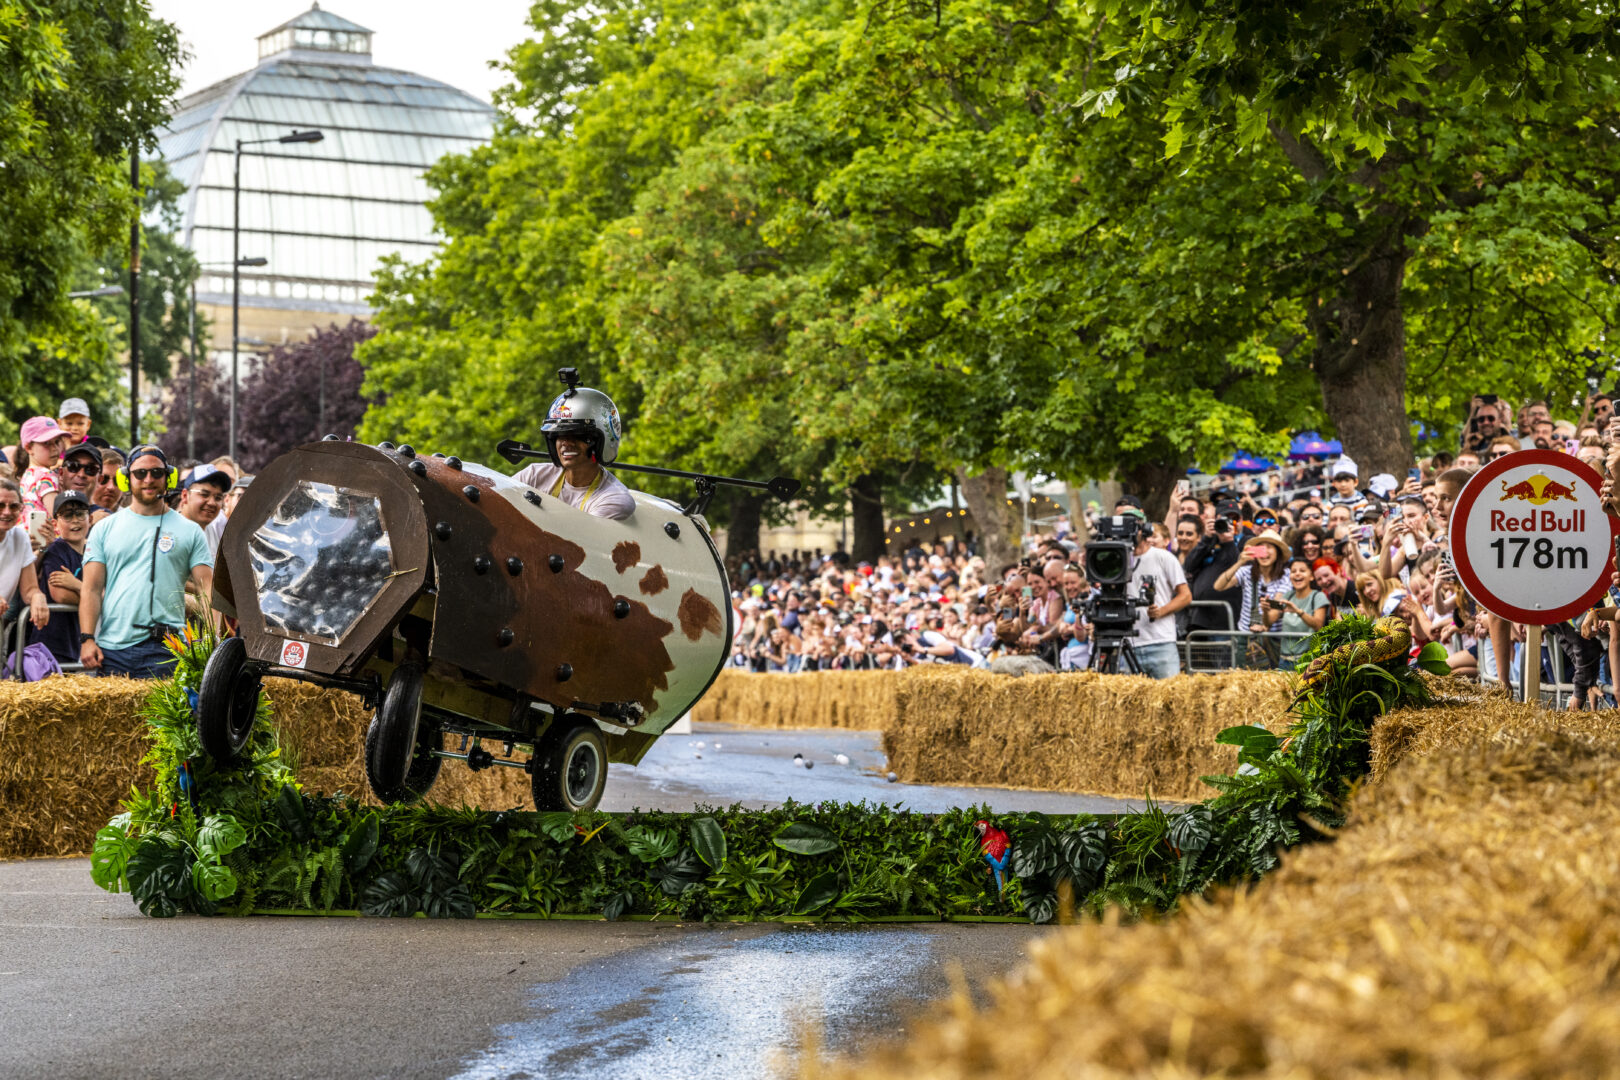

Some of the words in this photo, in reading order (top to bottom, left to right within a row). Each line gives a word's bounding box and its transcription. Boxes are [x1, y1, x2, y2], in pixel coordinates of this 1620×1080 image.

[1490, 509, 1536, 532] Red
[1541, 509, 1585, 532] Bull
[1490, 537, 1588, 569] 178m
[290, 645, 300, 653] 07
